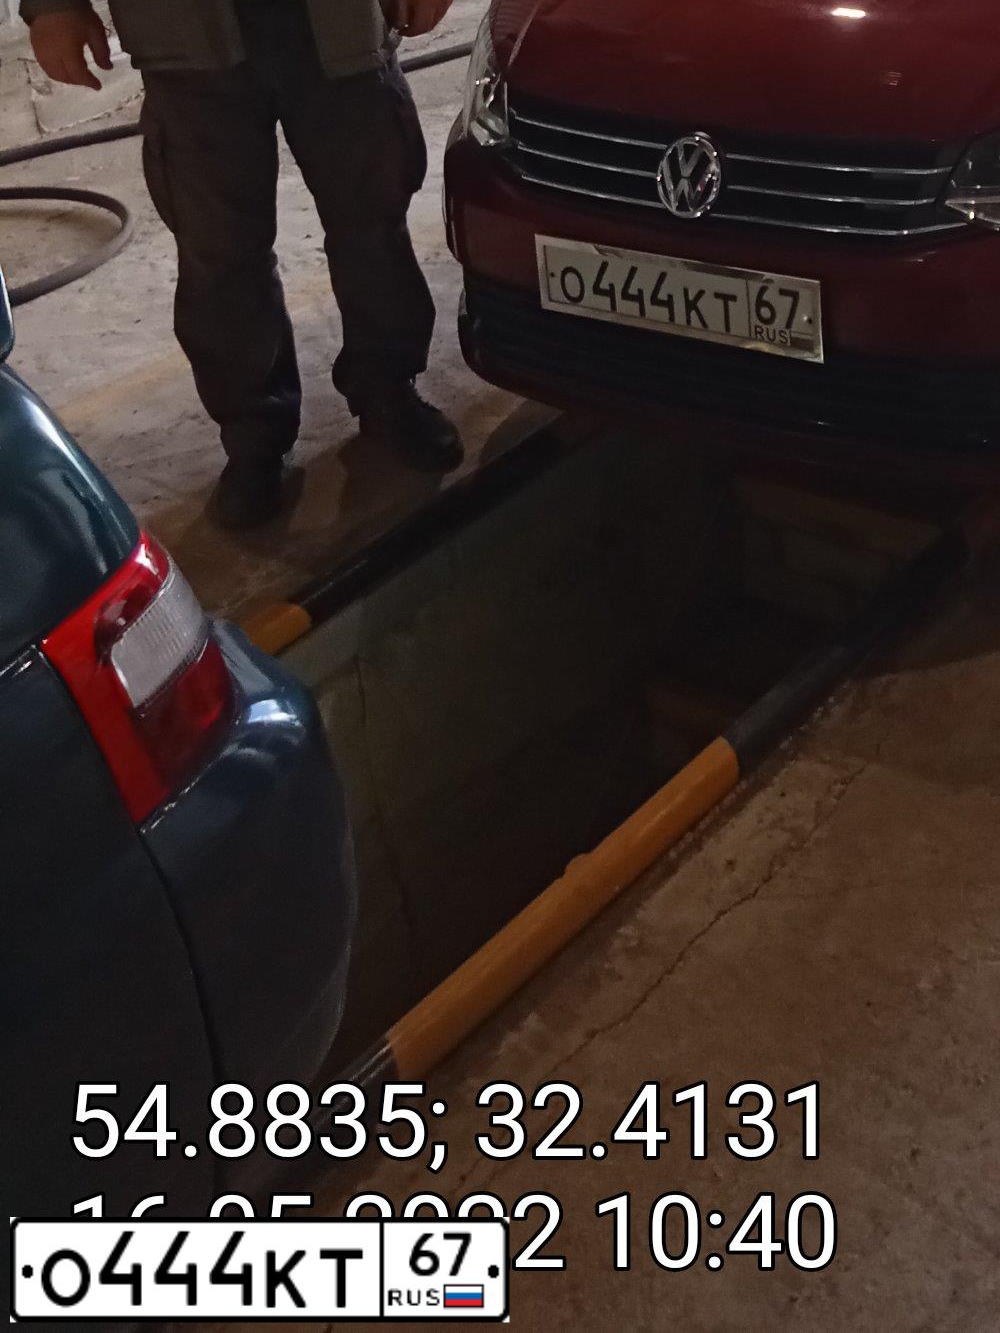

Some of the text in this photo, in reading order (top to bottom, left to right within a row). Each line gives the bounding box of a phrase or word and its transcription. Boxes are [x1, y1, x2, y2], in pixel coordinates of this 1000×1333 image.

[560, 261, 800, 333] О444КТ 67
[754, 324, 792, 344] RUS
